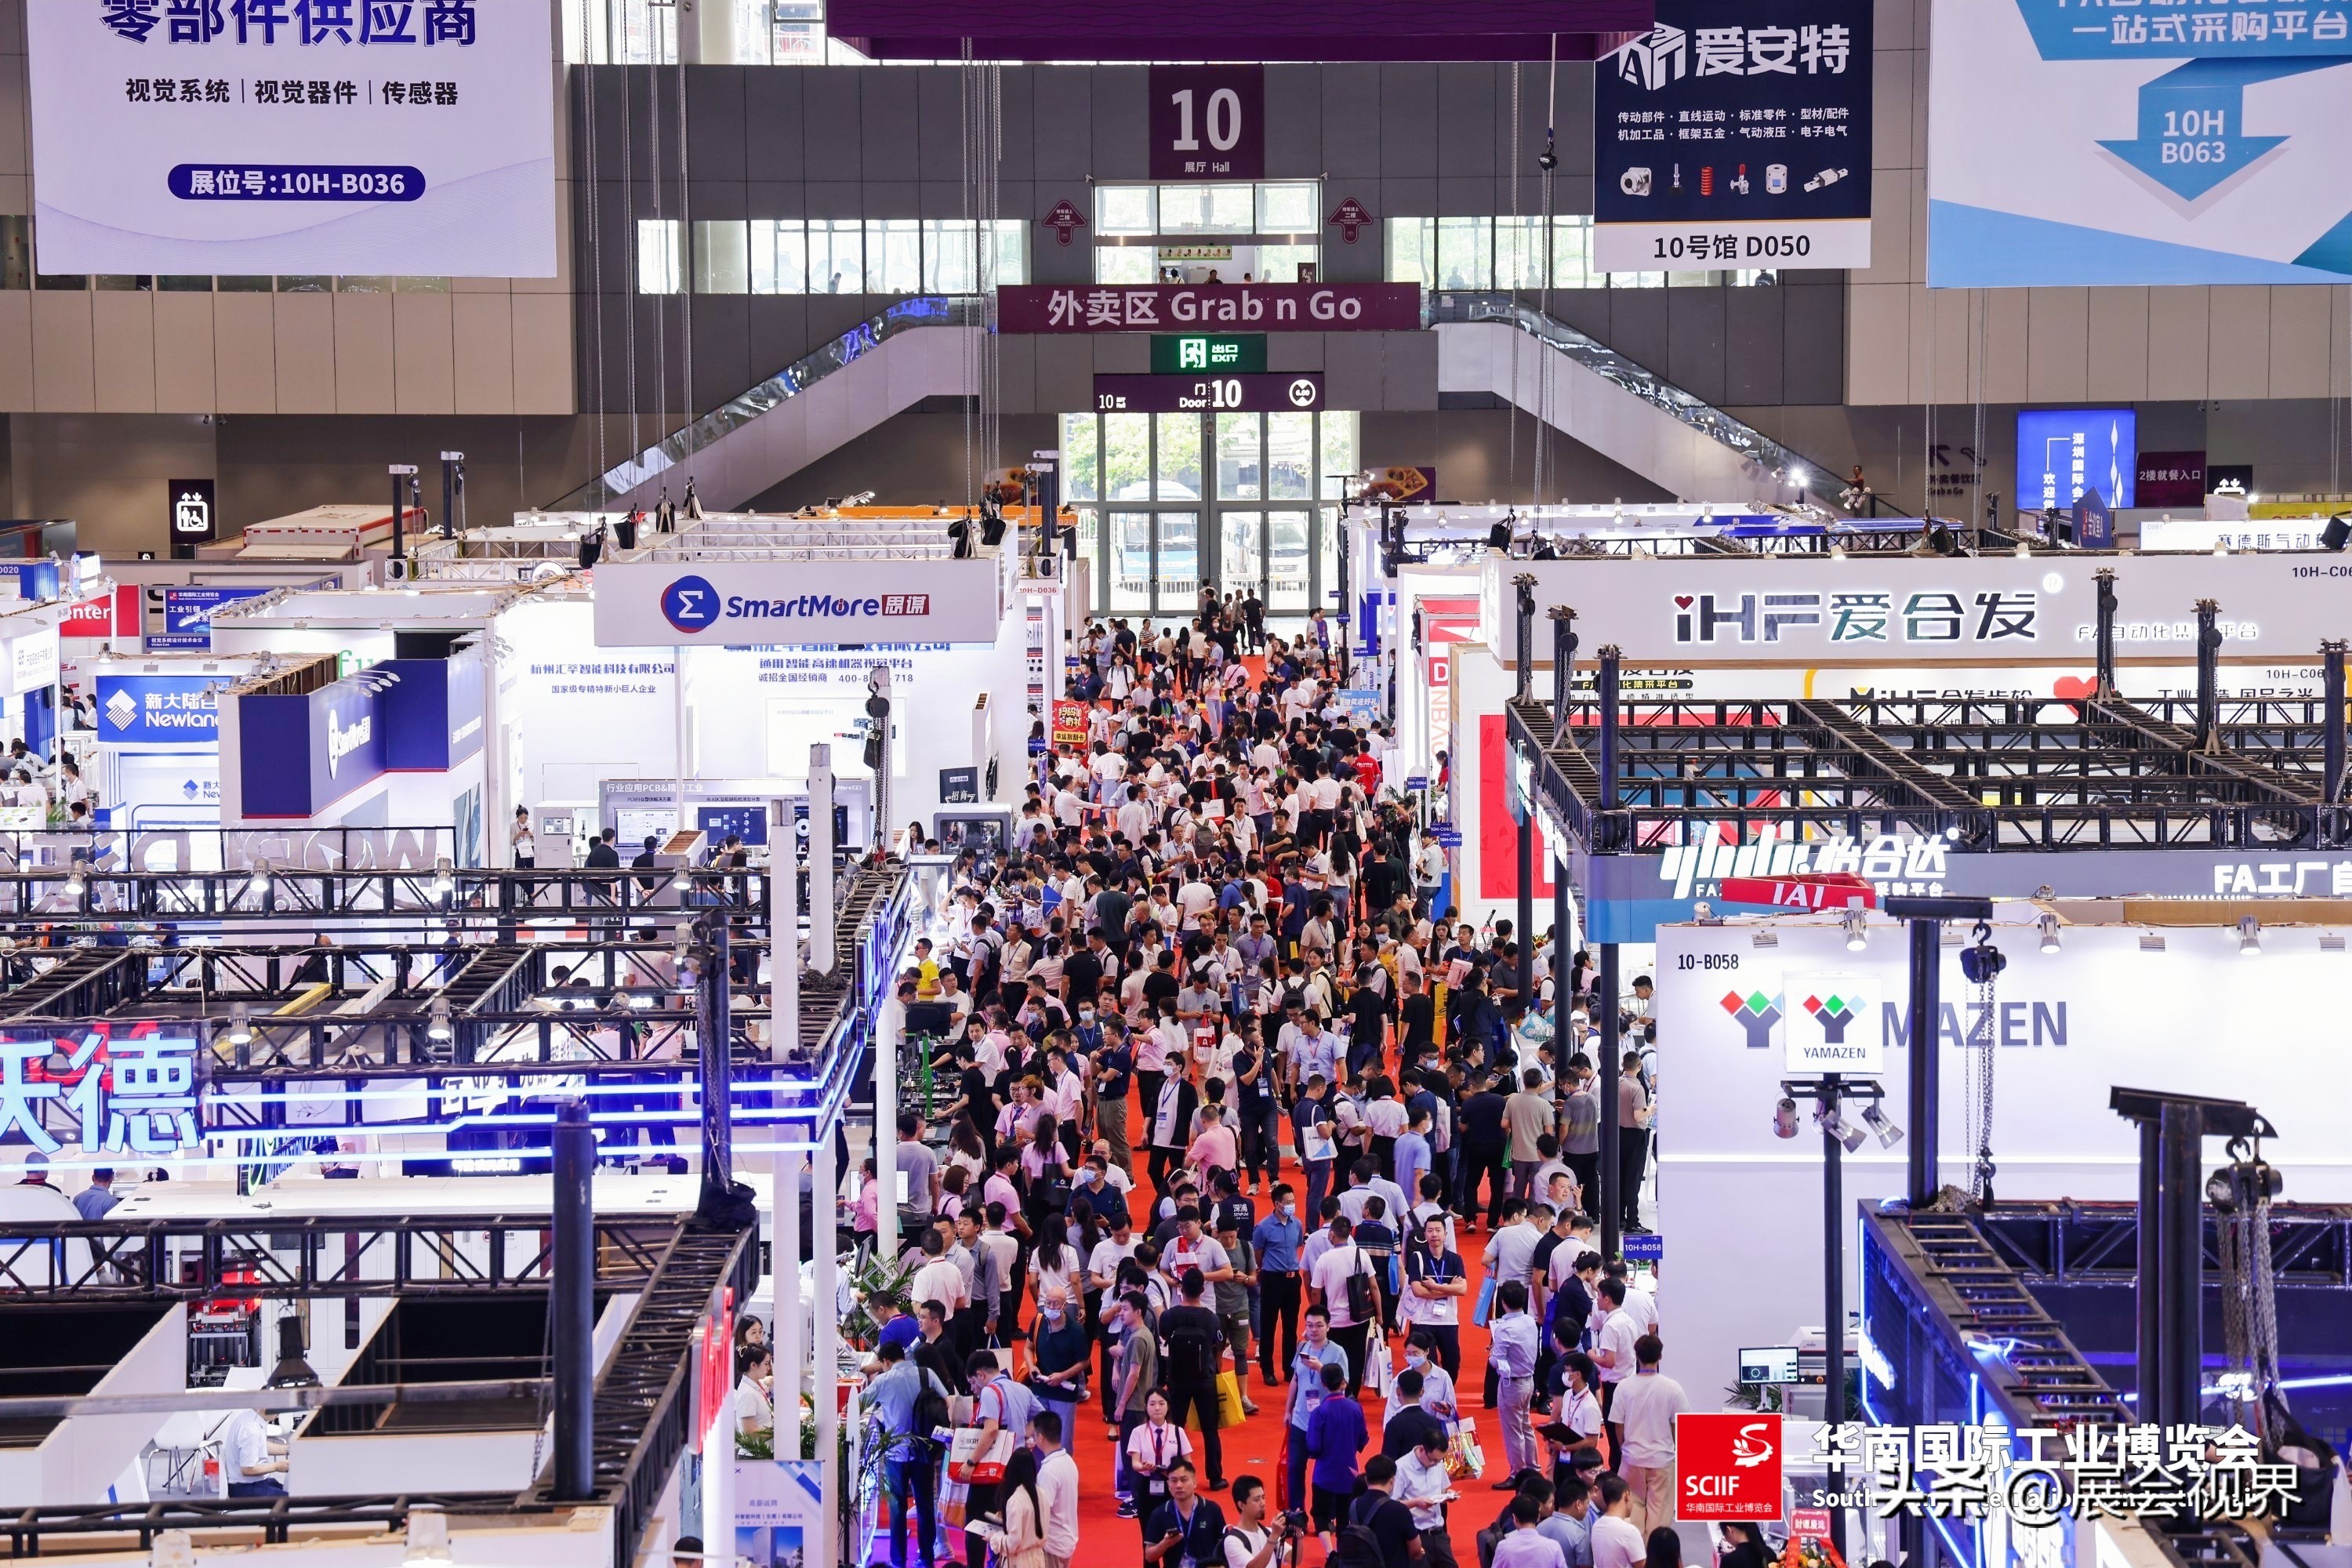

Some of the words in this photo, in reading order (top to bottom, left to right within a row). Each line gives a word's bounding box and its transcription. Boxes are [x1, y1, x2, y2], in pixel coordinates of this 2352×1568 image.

[100, 0, 477, 45] 零部件供应商
[2072, 10, 2349, 45] 一站式采购平台
[1695, 24, 1850, 77] 爱安特
[125, 78, 230, 103] 视觉系统
[254, 79, 358, 105] 视觉器件
[382, 81, 459, 106] 传感器
[1171, 88, 1242, 151] 10
[1617, 111, 1665, 123] 传动部件
[1678, 110, 1726, 122] 直线运动
[1739, 109, 1787, 121] 标准零件
[1800, 107, 1849, 120] 型材/配件
[2163, 110, 2225, 137] 10H
[1617, 129, 1664, 141] 机加工品
[1678, 127, 1726, 140] 框架五金
[1739, 126, 1787, 139] 气动液压
[1800, 125, 1848, 137] 电子电气
[2161, 141, 2226, 165] B063
[1184, 162, 1207, 173] 展厅
[1212, 162, 1230, 172] Hall
[1653, 234, 1738, 260] 10号馆
[1746, 235, 1810, 257] D050
[1047, 290, 1160, 326] 外卖区
[1171, 290, 1264, 321] Grab
[1277, 297, 1297, 320] n
[1309, 290, 1362, 321] Go
[1211, 344, 1238, 353] 出口
[1098, 394, 1113, 408] 10
[1179, 397, 1207, 408] Door
[1195, 383, 1207, 395] 门
[1211, 379, 1242, 408] 10
[2071, 433, 2085, 503] 深圳国际会
[2140, 470, 2201, 481] 2楼就餐入口
[724, 593, 880, 618] SmartMore
[883, 593, 927, 616] 思谋
[1829, 592, 2036, 642] 爱合发
[759, 658, 913, 669] 通用智能高速机器视觉平台
[758, 673, 828, 683] 诚招全国经销商
[1582, 680, 1679, 689] FA化集采平台
[551, 684, 656, 694] 国家级专精特新小巨人企业
[951, 789, 968, 801] 招商
[1812, 833, 1951, 878] 怡合达
[1772, 883, 1825, 908] IAI
[1678, 953, 1740, 971] 10-B058
[1803, 1047, 1867, 1060] YAMAZEN
[1624, 1243, 1662, 1252] 10H-B058
